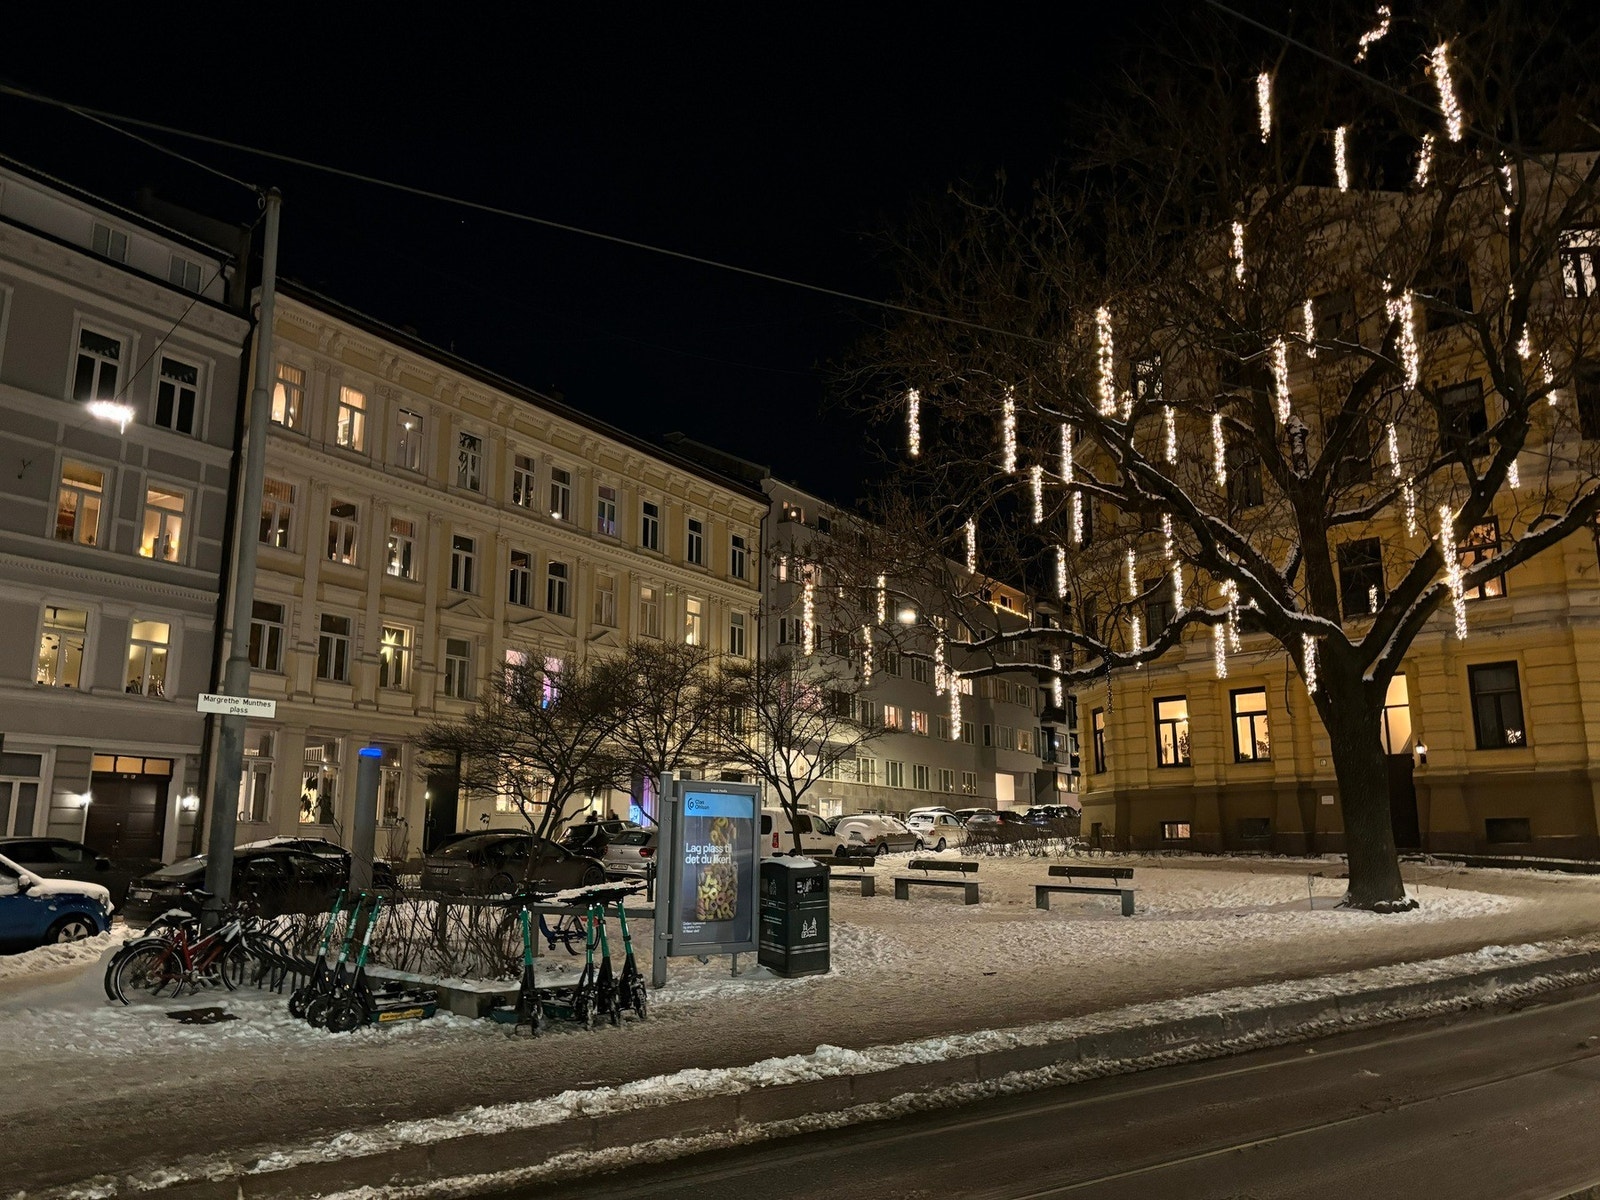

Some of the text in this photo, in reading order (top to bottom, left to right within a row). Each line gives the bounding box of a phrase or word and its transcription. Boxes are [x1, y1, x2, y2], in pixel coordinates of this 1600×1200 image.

[203, 695, 271, 707] Margrethe Munthes
[229, 706, 248, 714] plass
[685, 843, 732, 854] Lag plass til
[685, 853, 700, 864] det
[701, 854, 712, 864] du
